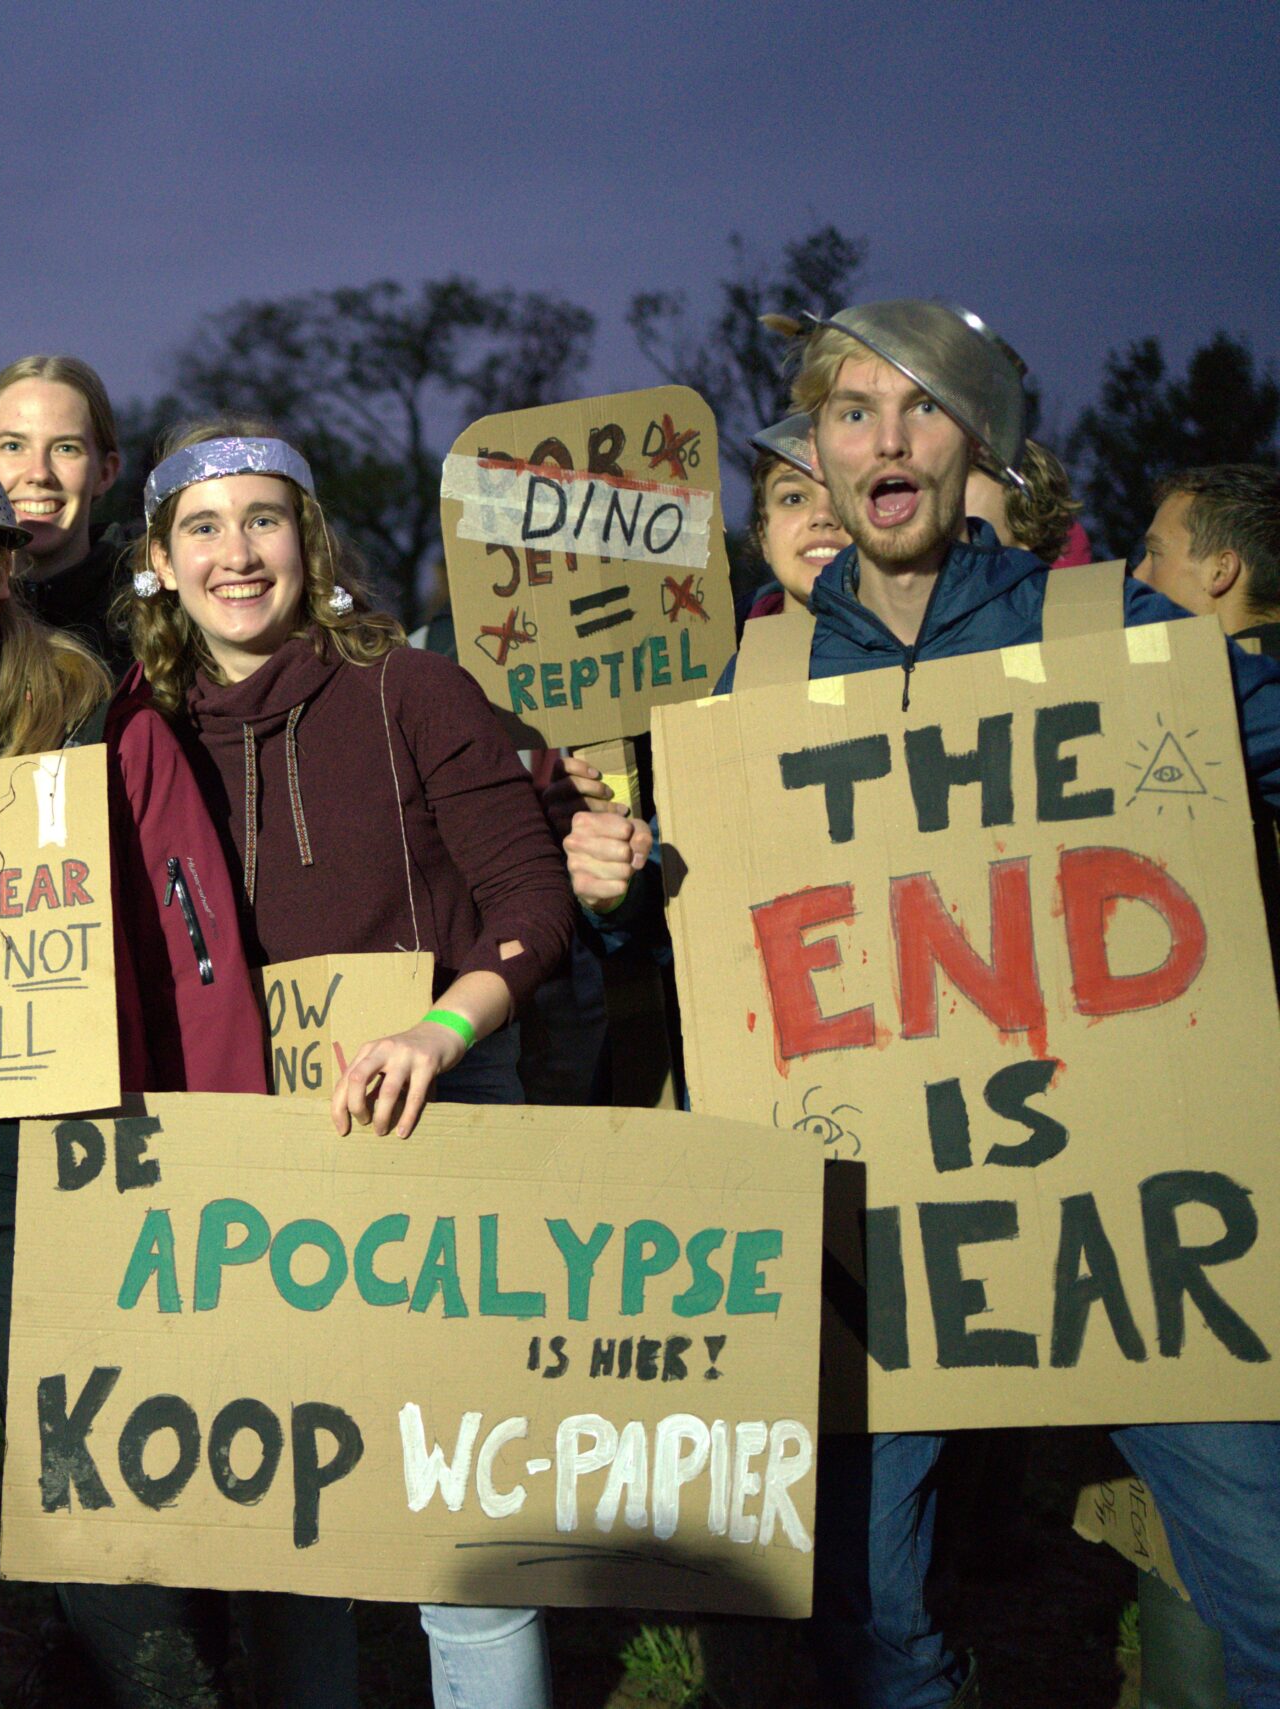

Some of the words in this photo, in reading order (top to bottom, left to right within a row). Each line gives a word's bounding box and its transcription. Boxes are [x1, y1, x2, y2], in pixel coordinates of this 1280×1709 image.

[522, 476, 683, 553] DINO
[507, 628, 707, 714] REPTIEL
[778, 701, 1115, 843] THE
[5, 923, 101, 980] NOT
[751, 846, 1208, 1060] END
[52, 1115, 164, 1193] DE
[925, 1058, 1070, 1173] IS
[116, 1198, 784, 1320] APOCALYPSE
[527, 1336, 570, 1379] IS
[38, 1365, 365, 1549] KOOP
[398, 1401, 813, 1553] WC-PAPIER
